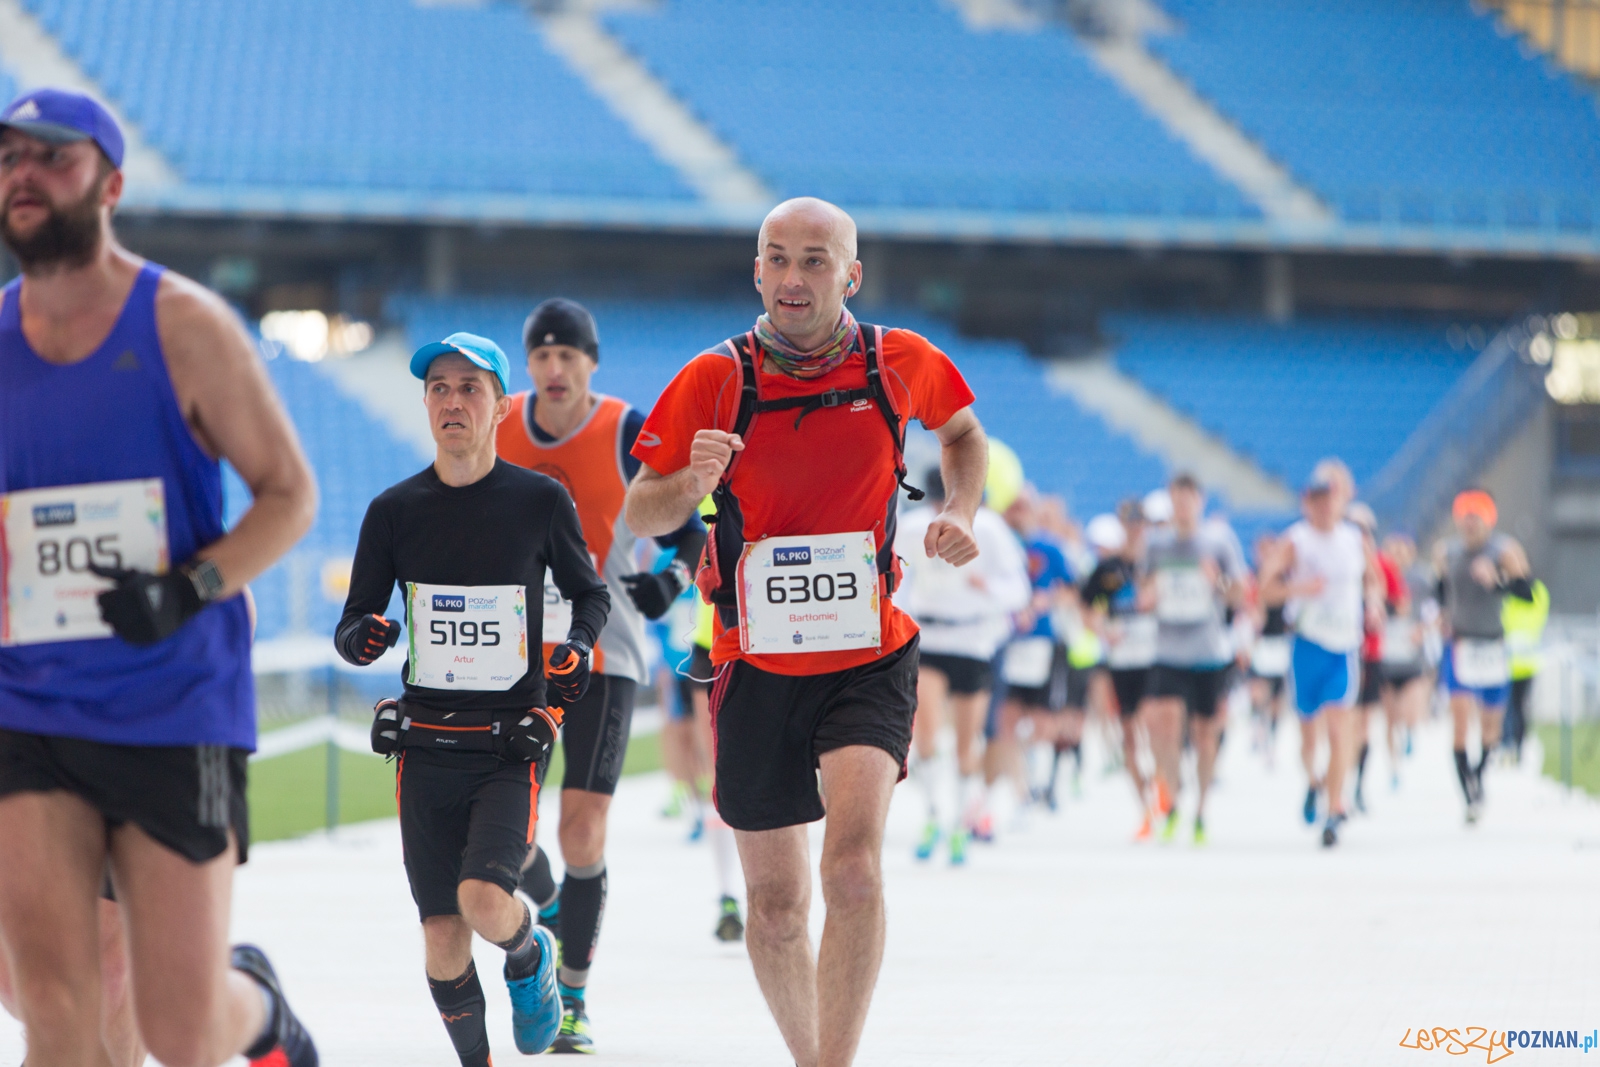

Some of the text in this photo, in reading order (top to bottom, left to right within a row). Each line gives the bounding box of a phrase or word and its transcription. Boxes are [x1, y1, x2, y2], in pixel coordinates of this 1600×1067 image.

[38, 534, 123, 575] 805
[814, 553, 845, 561] maraton
[766, 572, 858, 604] 6303
[789, 612, 838, 623] Bartłomiej
[430, 620, 500, 646] 5195
[454, 655, 475, 664] Artur
